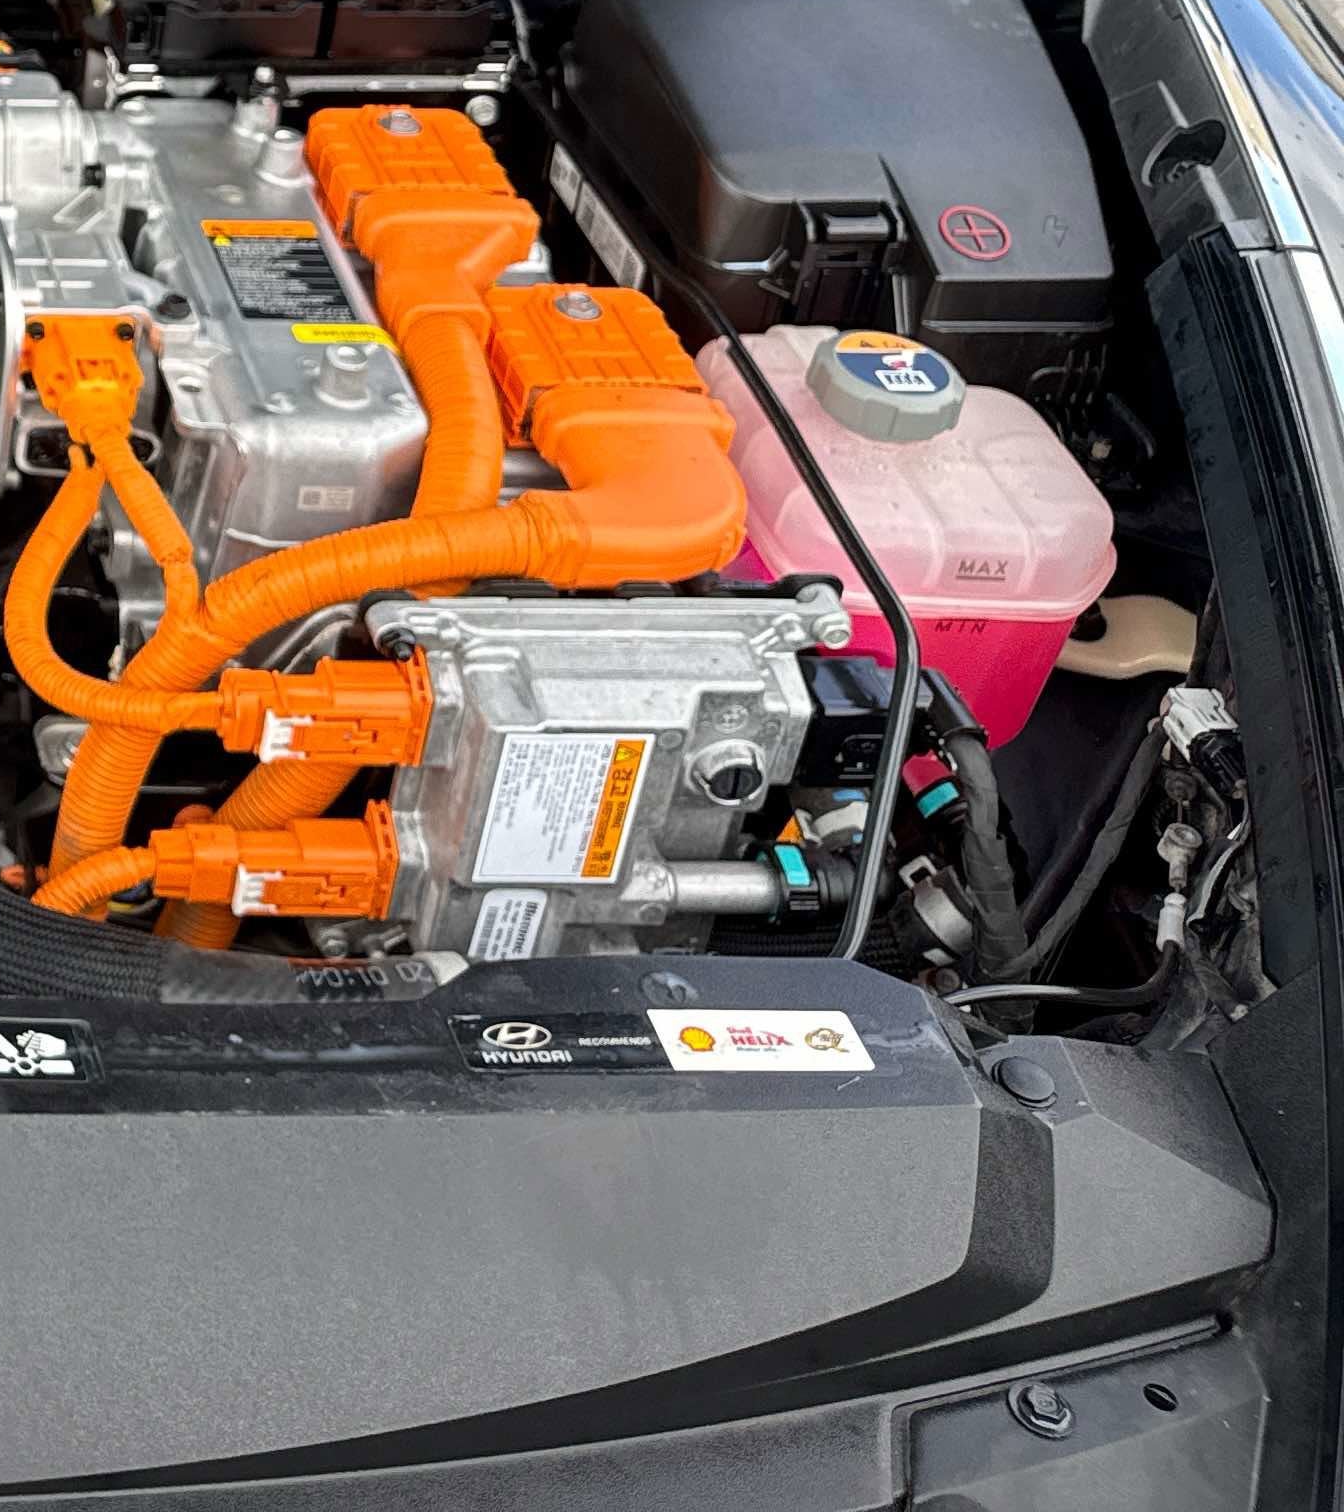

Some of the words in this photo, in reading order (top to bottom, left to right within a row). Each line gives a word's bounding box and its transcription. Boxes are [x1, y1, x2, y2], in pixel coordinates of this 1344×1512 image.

[957, 559, 1009, 576] MAX
[934, 620, 987, 634] MIN
[730, 1032, 794, 1047] HELIX
[481, 1049, 574, 1065] HYUNDAI
